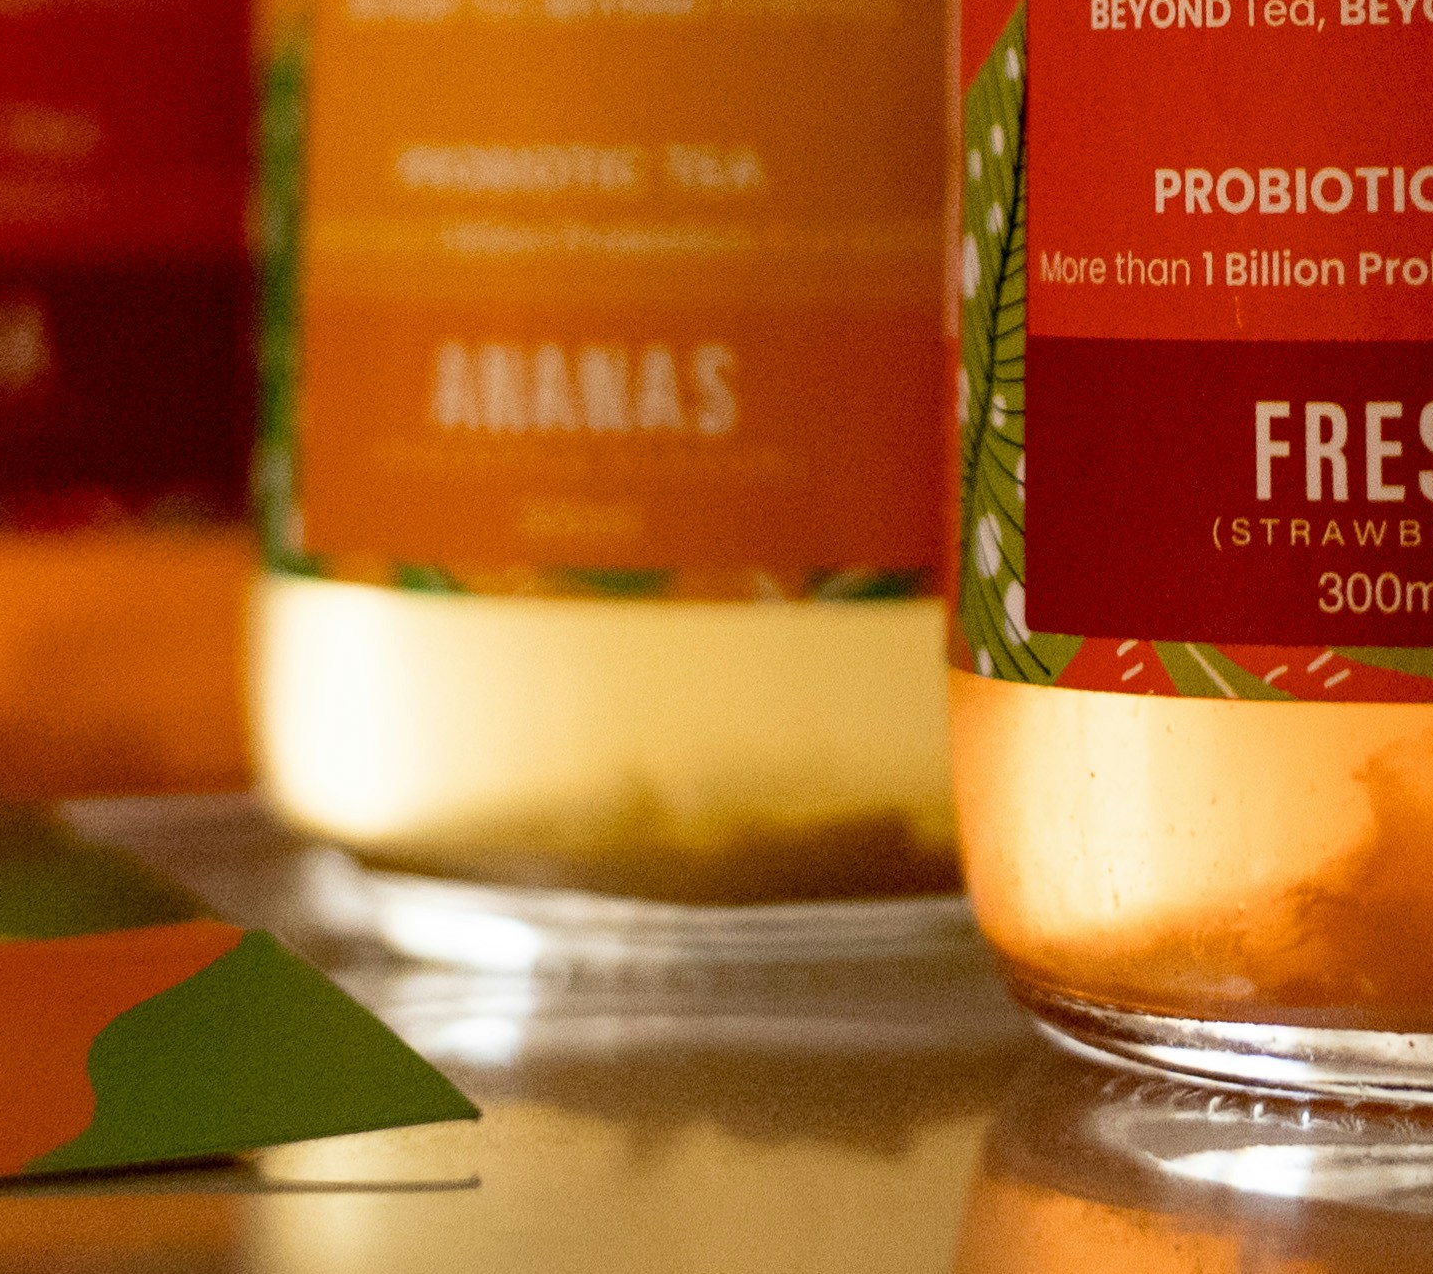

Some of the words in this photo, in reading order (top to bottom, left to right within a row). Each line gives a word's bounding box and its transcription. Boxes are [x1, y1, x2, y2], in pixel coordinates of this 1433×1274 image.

[1039, 250, 1107, 285] More
[1115, 249, 1191, 286] than
[1202, 251, 1214, 287] 1
[1225, 248, 1345, 288] Billion
[433, 343, 737, 436] ANANAS
